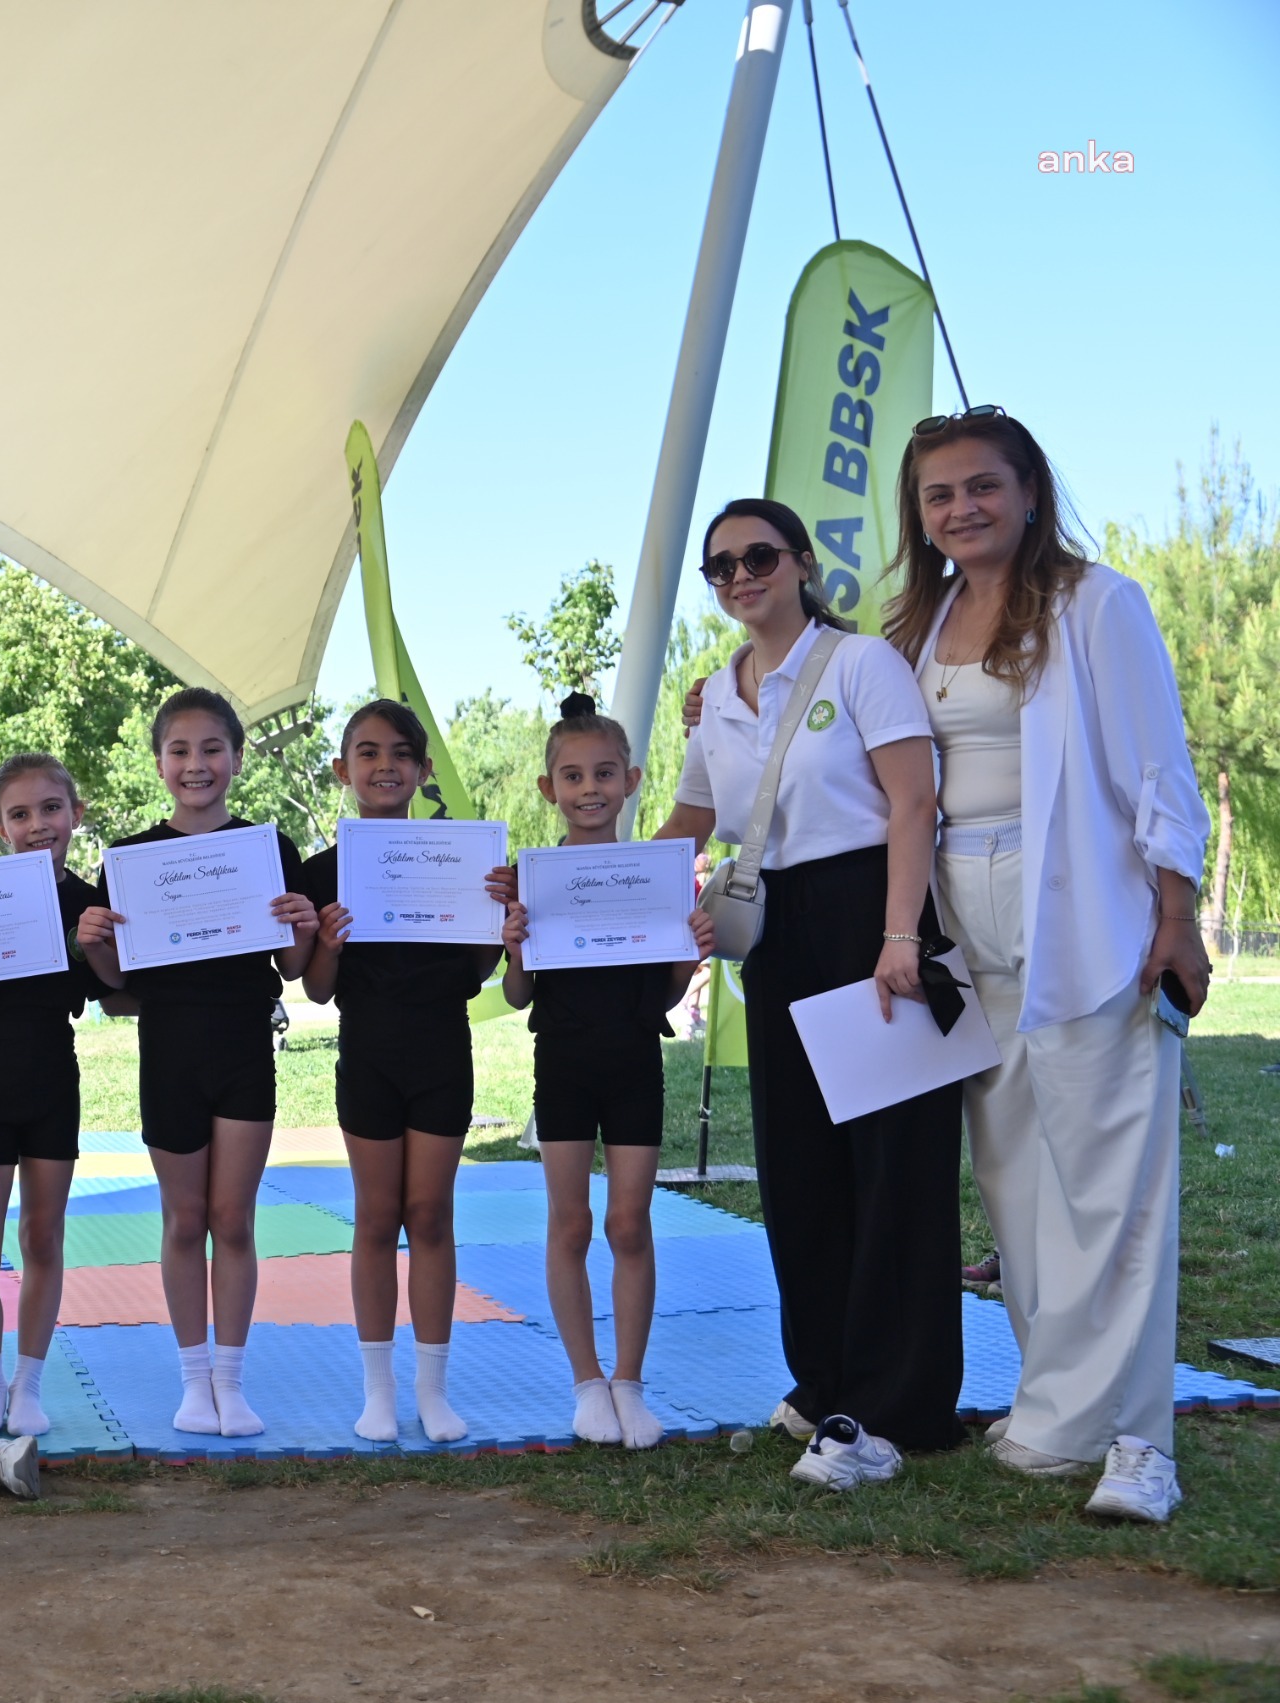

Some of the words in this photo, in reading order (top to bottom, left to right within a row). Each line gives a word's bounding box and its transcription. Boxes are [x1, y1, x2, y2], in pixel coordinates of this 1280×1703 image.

[822, 286, 891, 497] BBSK
[814, 516, 864, 634] SA
[417, 851, 461, 866] Sertifikası
[194, 865, 238, 880] Sertifikası
[606, 874, 650, 889] Sertifikası
